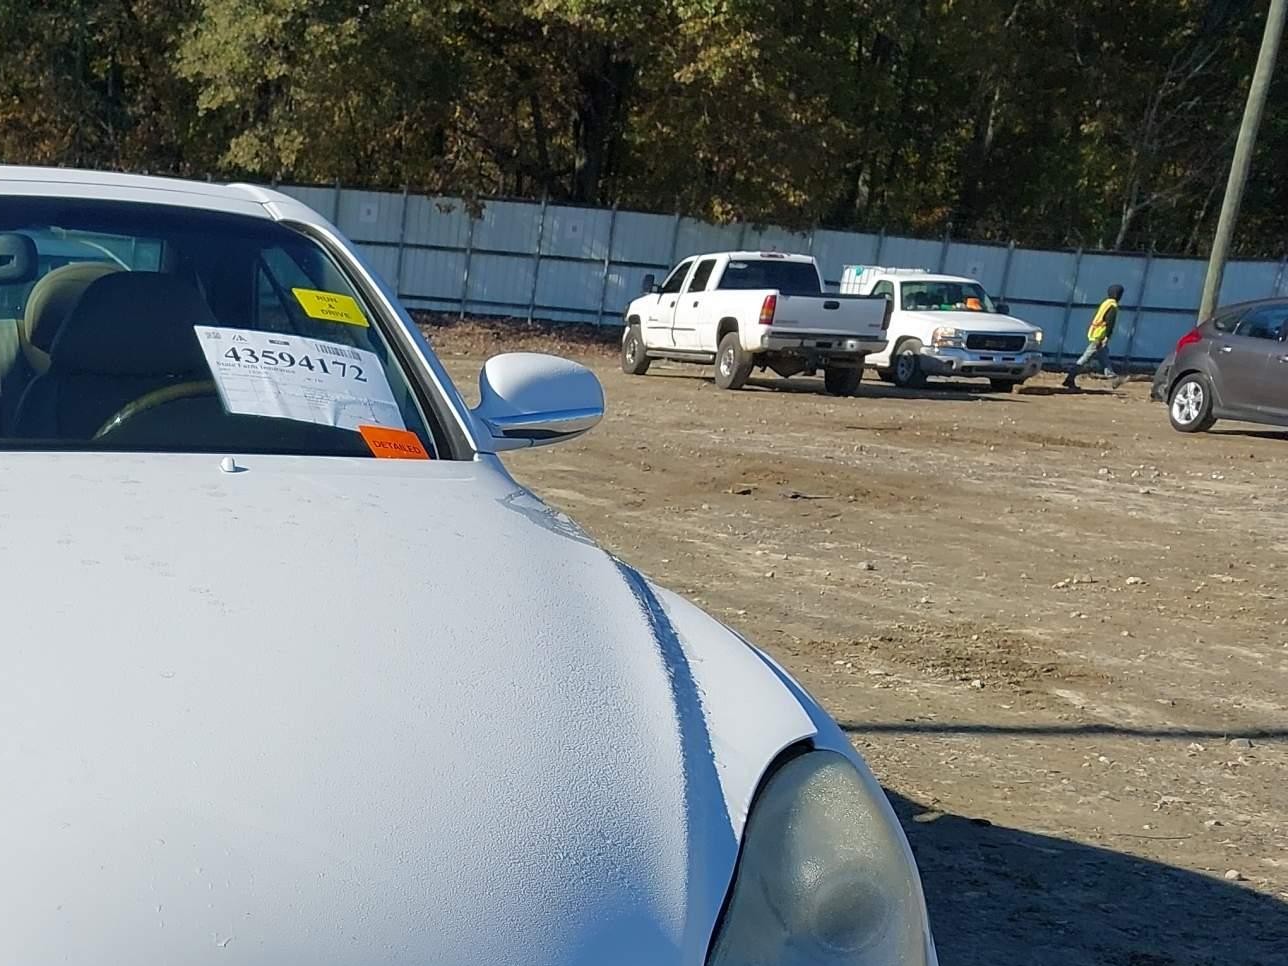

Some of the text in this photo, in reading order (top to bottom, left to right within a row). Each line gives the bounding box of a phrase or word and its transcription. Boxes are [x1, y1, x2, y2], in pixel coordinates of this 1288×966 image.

[315, 295, 339, 303] RUN
[320, 308, 352, 319] DRIVE
[223, 346, 369, 383] 43594172
[371, 439, 422, 455] DETAILED
